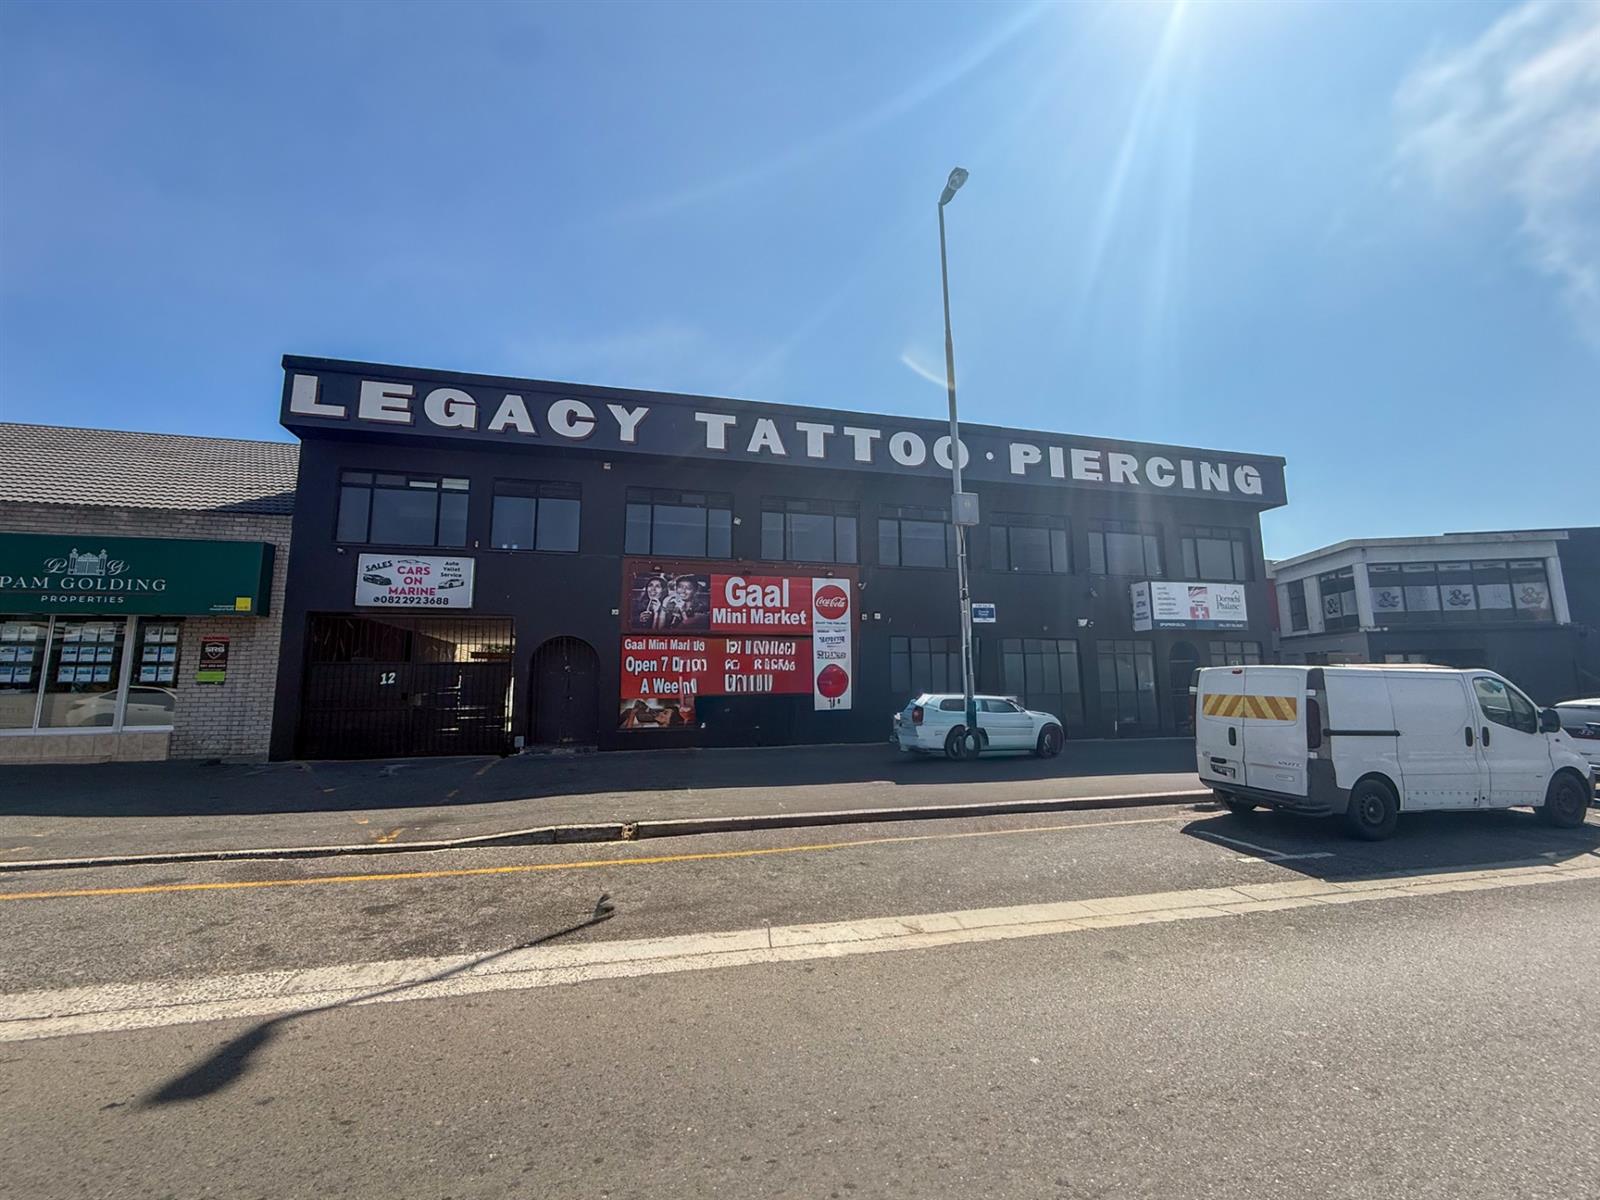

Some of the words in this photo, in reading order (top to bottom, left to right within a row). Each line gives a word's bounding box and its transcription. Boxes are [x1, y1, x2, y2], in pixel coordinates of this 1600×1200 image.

[290, 373, 650, 442] LEGACY
[695, 412, 970, 470] TATTOO
[1009, 442, 1263, 495] PIERCING
[365, 560, 393, 573] SALES
[397, 565, 431, 576] CARS
[0, 575, 49, 589] PAM
[60, 576, 167, 592] GOLDING
[403, 576, 423, 586] ON
[388, 586, 436, 597] MARINE
[725, 576, 790, 608] Gaal
[40, 594, 125, 604] PROPERTIES
[712, 608, 747, 624] Mini
[750, 609, 807, 626] Market
[624, 638, 646, 650] Gaal
[648, 638, 668, 650] Mini
[625, 656, 658, 676] Open
[660, 657, 669, 672] 7
[380, 672, 396, 685] 12
[639, 678, 650, 694] A
